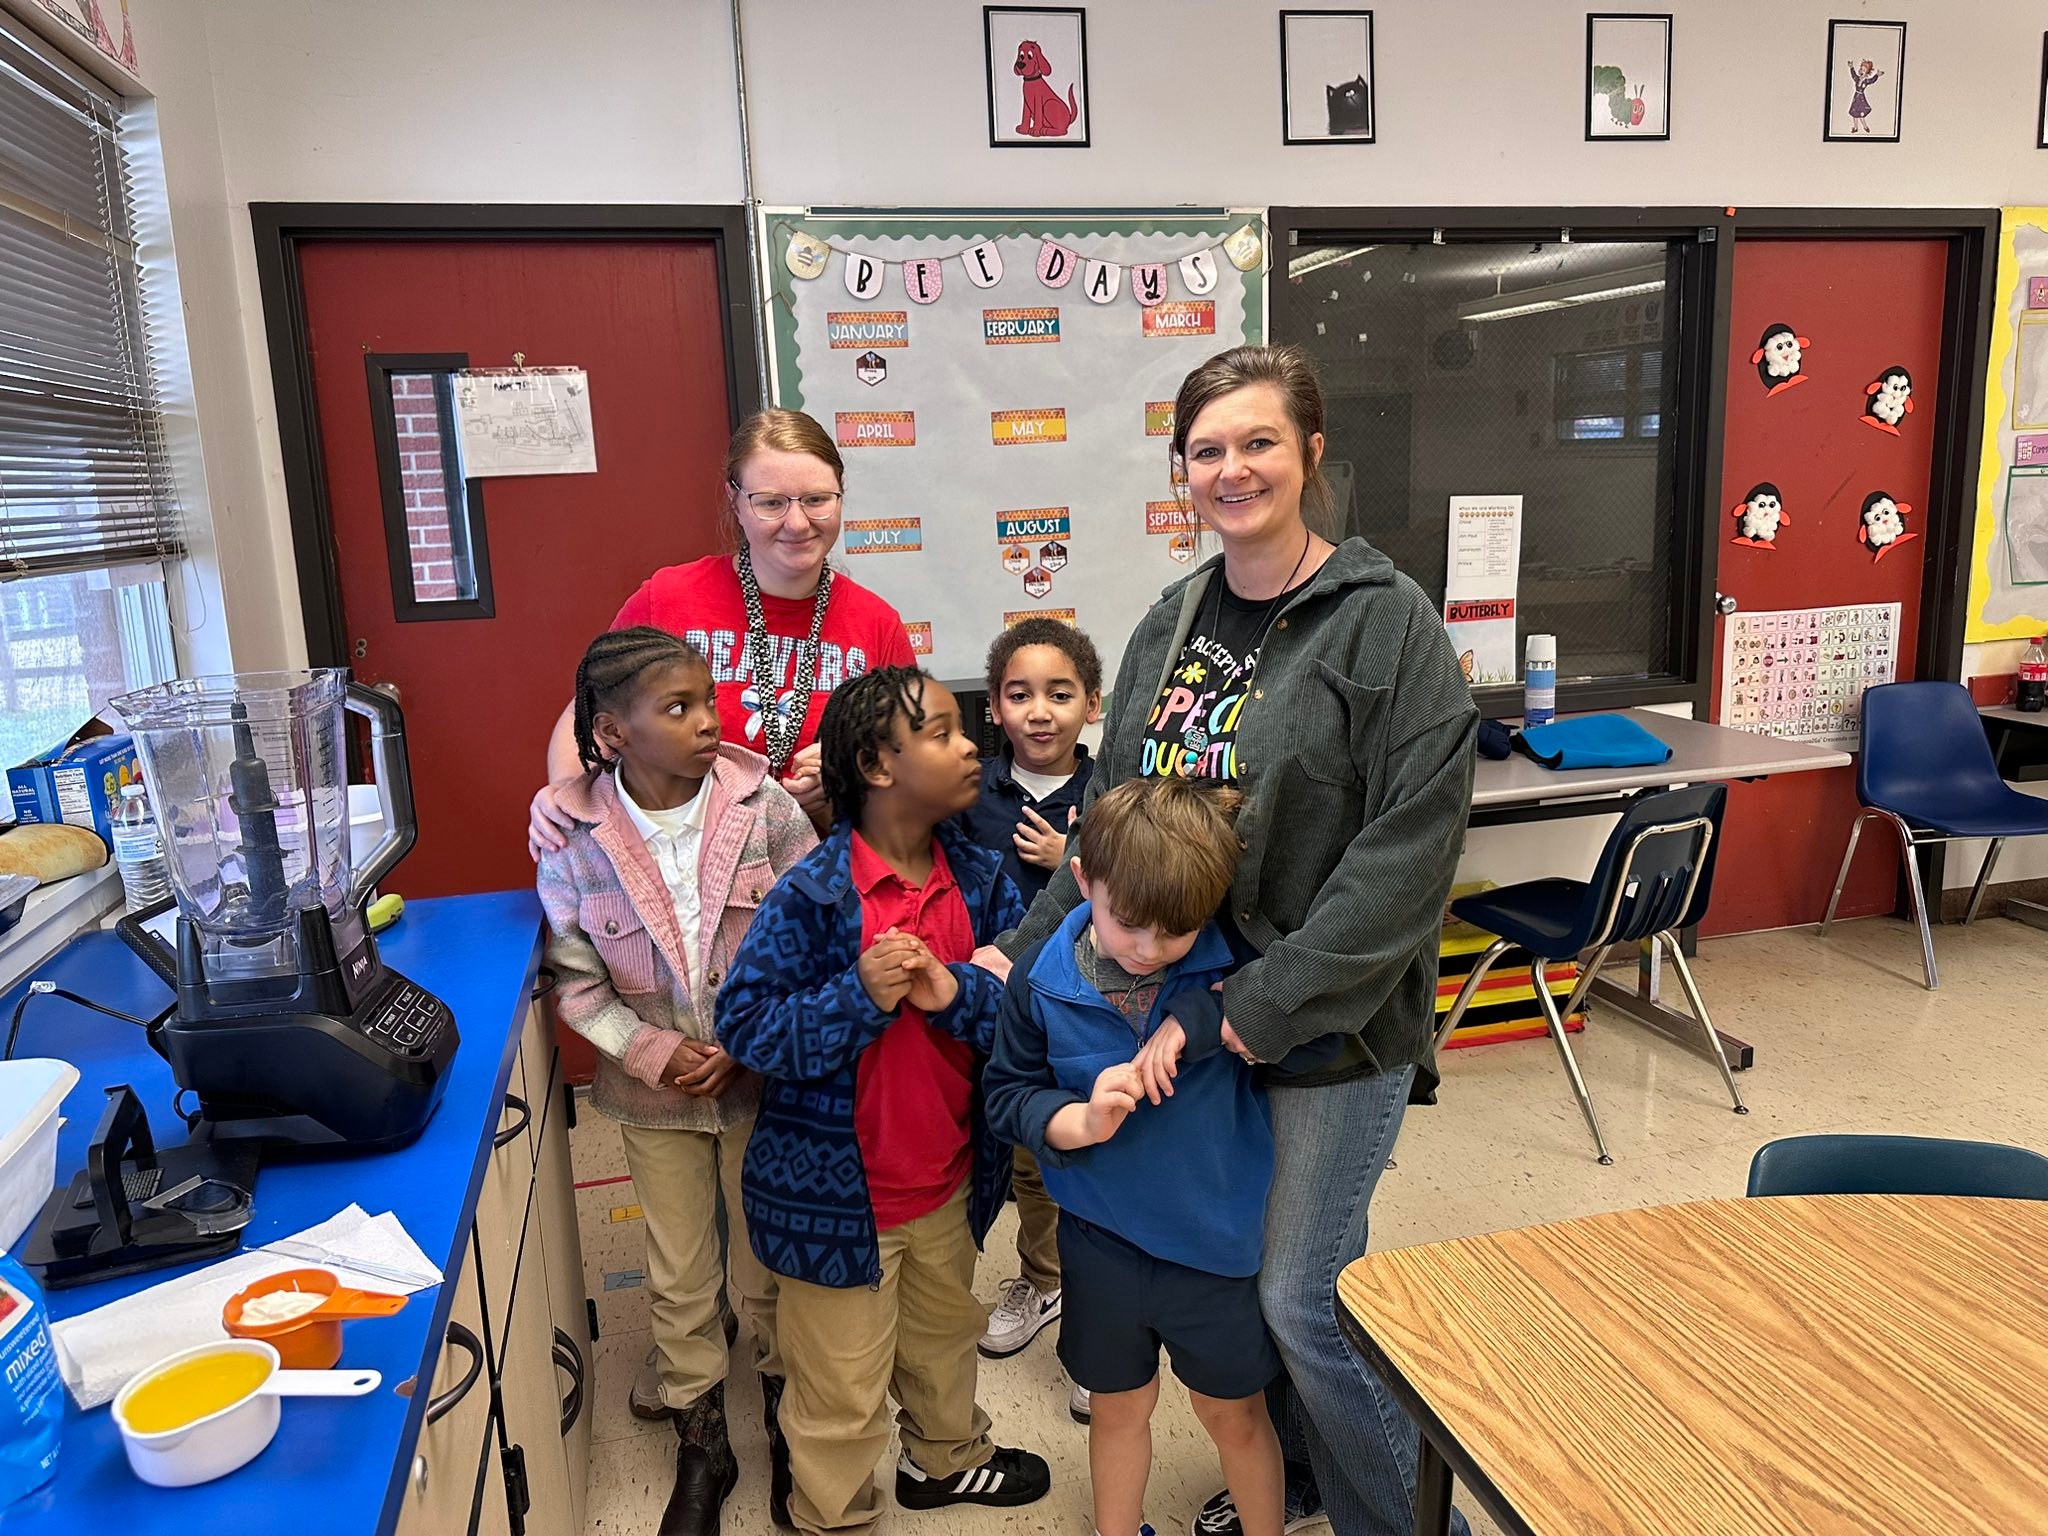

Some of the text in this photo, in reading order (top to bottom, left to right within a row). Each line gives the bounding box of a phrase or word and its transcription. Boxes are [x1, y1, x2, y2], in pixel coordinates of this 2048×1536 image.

[986, 319, 1056, 337] FEBRUARY
[1155, 312, 1201, 329] MARCH
[830, 324, 905, 340] JANUARY
[1011, 420, 1046, 436] MAY
[1162, 412, 1176, 427] JU
[856, 423, 895, 439] APRIL
[1005, 518, 1062, 536] AUGUST
[863, 530, 902, 546] JULY
[1449, 603, 1510, 620] BUTTERFLY
[1148, 686, 1246, 735] PECI
[384, 1013, 396, 1026] POWER
[0, 1312, 40, 1359] unsweetened
[5, 1323, 47, 1384] mixed
